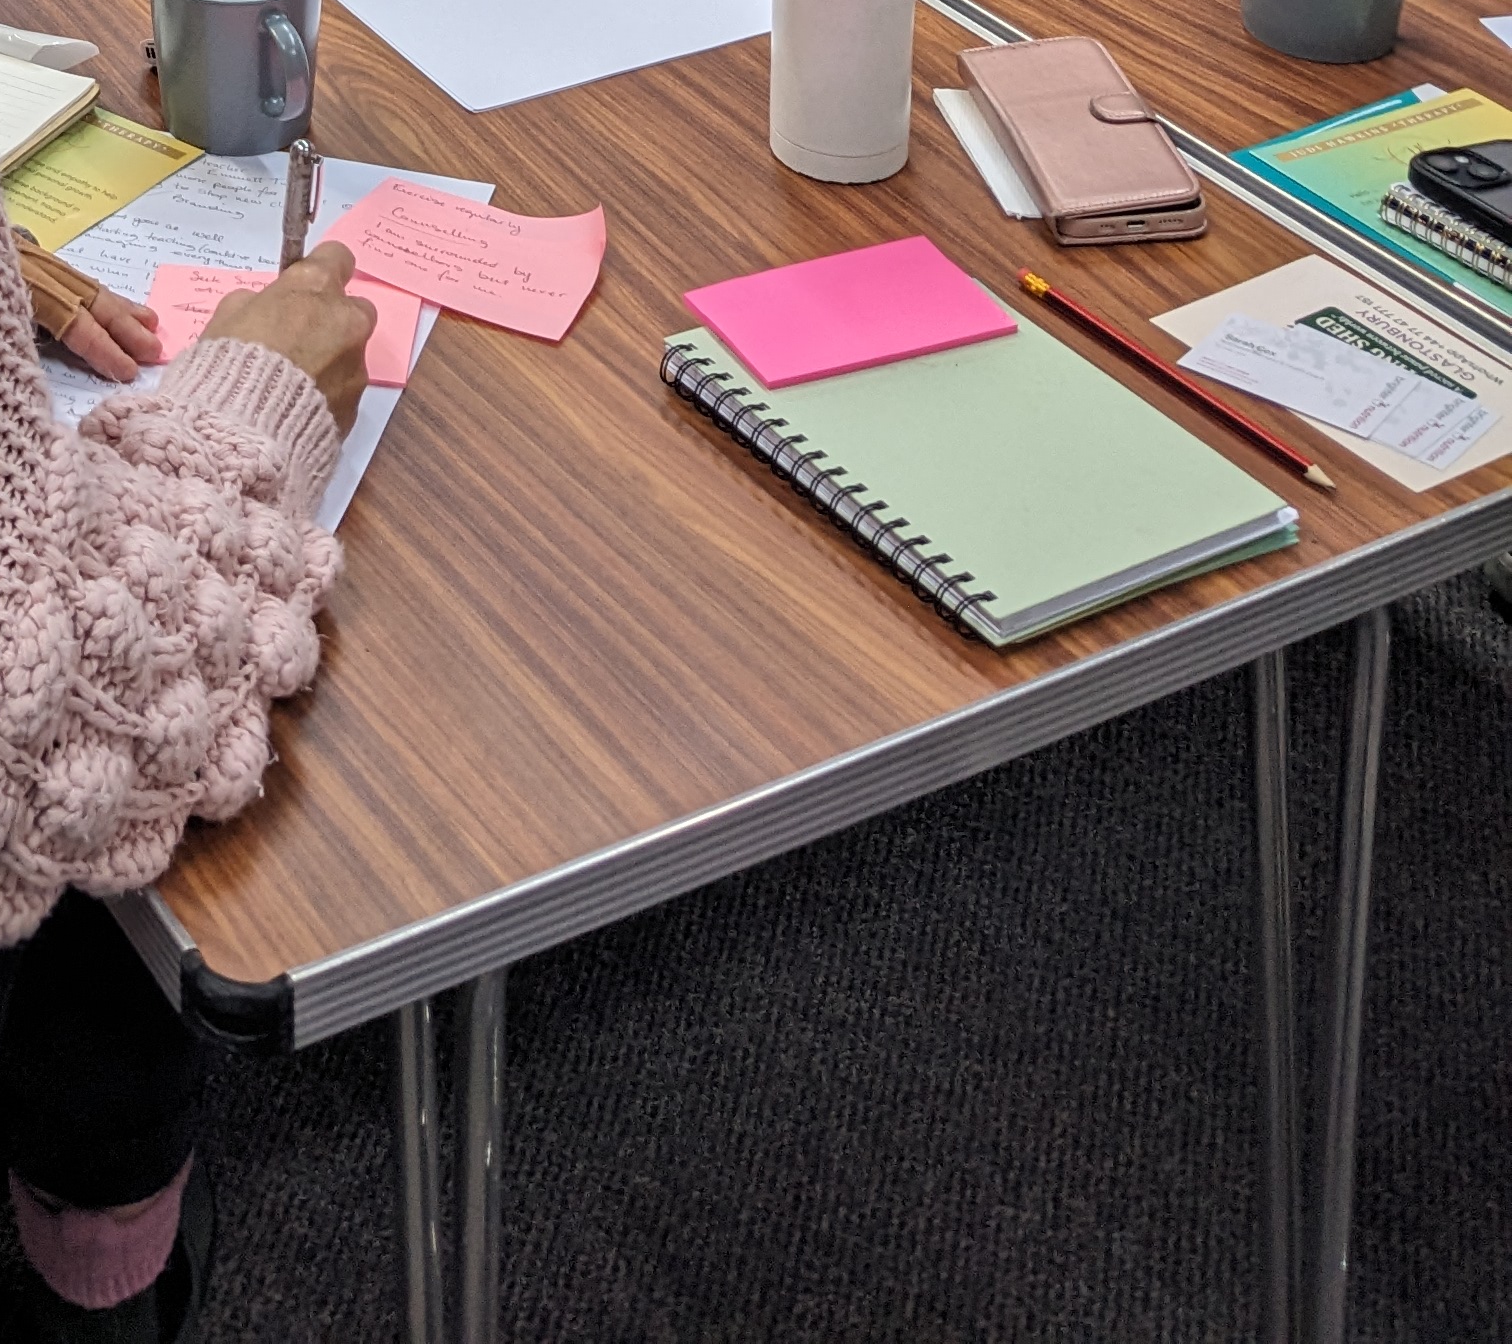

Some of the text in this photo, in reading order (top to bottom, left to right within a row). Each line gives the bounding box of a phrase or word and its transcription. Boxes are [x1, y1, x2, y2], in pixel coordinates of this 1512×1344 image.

[1329, 124, 1388, 149] HAWKINS
[514, 266, 533, 284] by
[1315, 315, 1371, 351] SHED
[1355, 309, 1476, 381] GLASTONBURY
